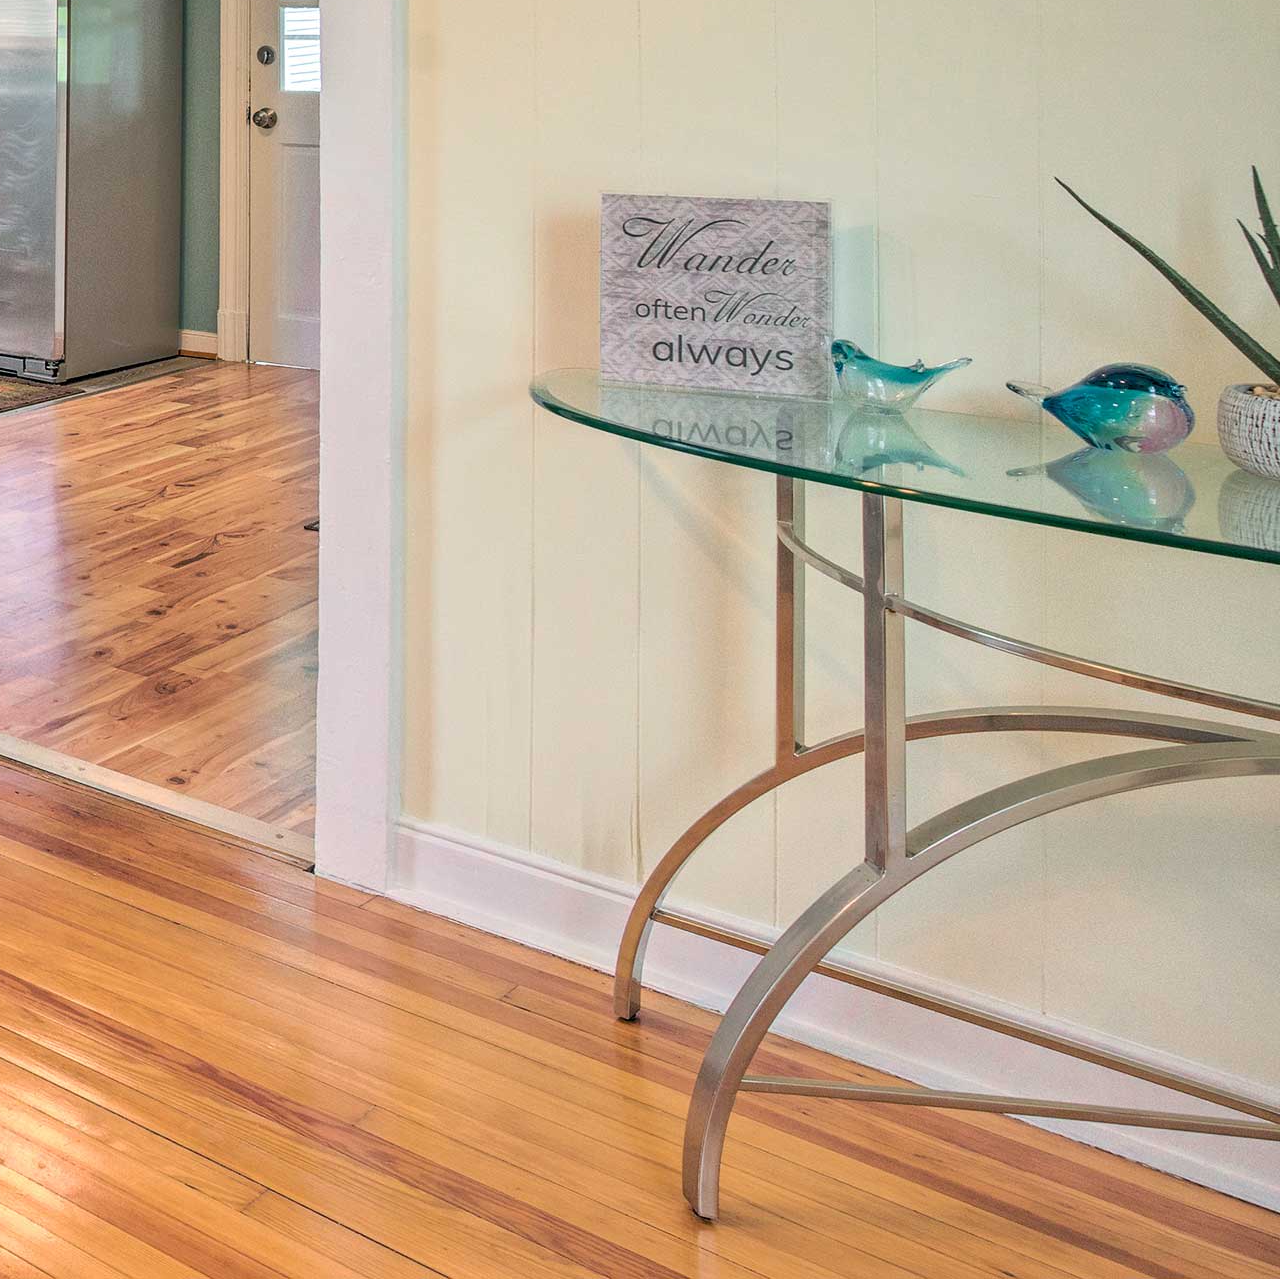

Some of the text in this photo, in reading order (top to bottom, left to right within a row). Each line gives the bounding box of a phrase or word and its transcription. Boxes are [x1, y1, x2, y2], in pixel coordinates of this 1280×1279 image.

[622, 216, 797, 276] Wander
[635, 290, 811, 329] often Wonder
[652, 334, 794, 377] always
